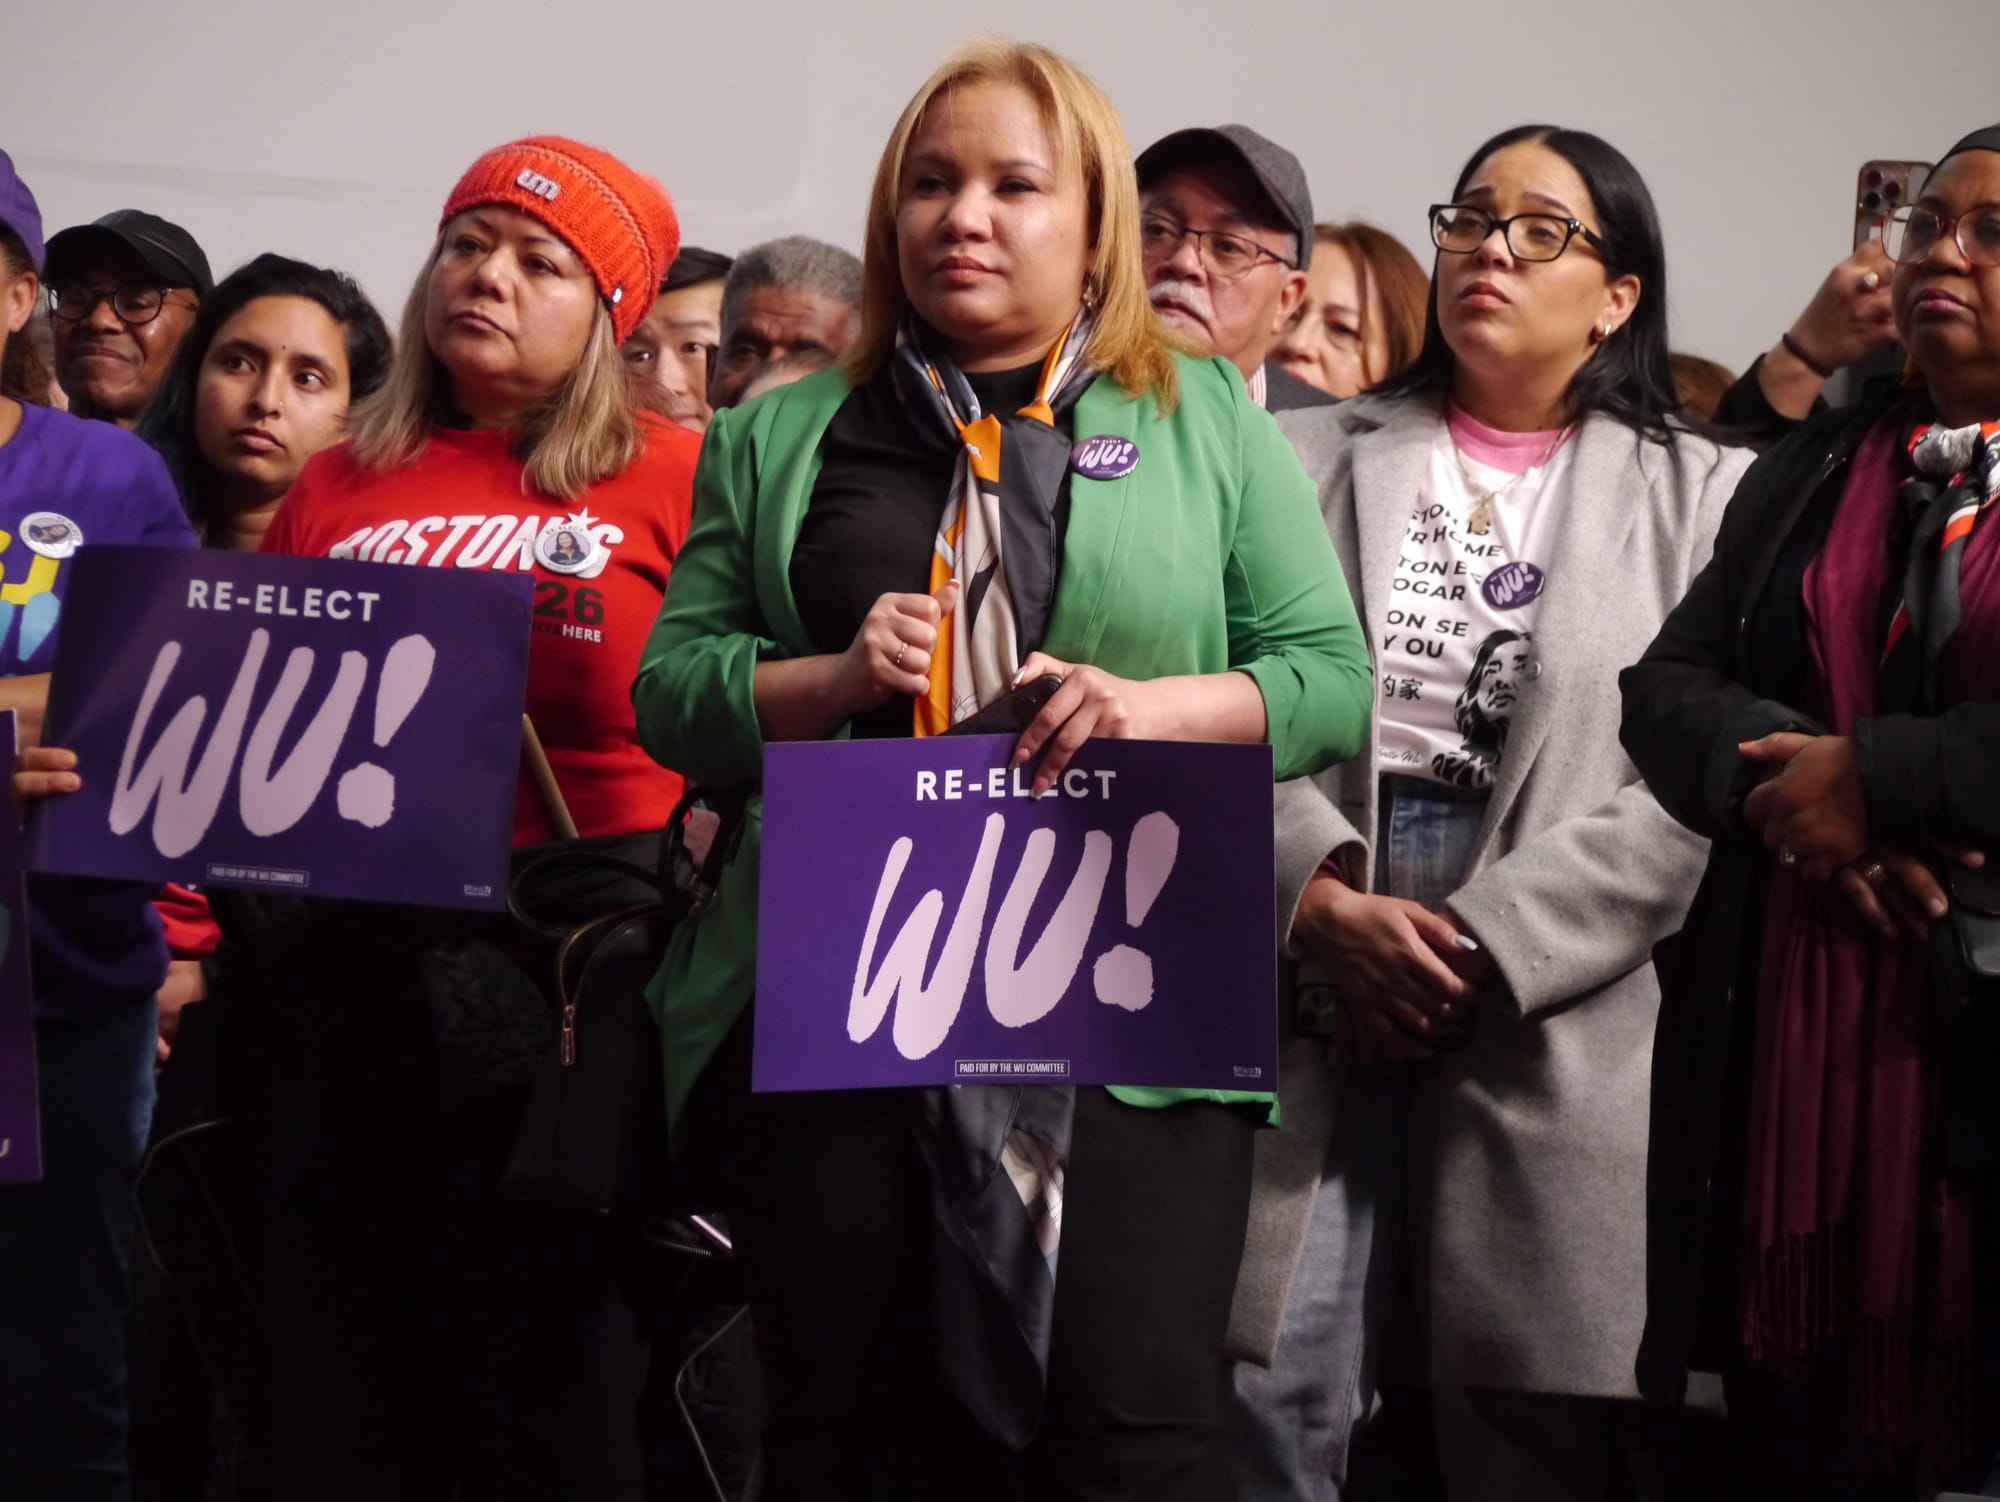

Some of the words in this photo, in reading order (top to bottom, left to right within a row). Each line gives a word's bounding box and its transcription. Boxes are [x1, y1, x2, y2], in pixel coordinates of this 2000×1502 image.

[1079, 443, 1133, 469] WU!
[187, 579, 380, 622] RE-ELECT
[1490, 562, 1535, 605] WU!
[535, 581, 605, 626] 26
[1434, 620, 1469, 637] SE
[1405, 638, 1445, 658] OU
[108, 628, 436, 858] WU!
[916, 769, 1117, 801] RE-ELCT
[847, 811, 1179, 1060] WU!
[960, 1062, 974, 1073] PAID
[976, 1062, 989, 1073] FOR
[990, 1063, 999, 1073] BY
[1000, 1063, 1013, 1073] THE
[1013, 1063, 1026, 1073] WU
[1026, 1063, 1065, 1073] COMMITTEE
